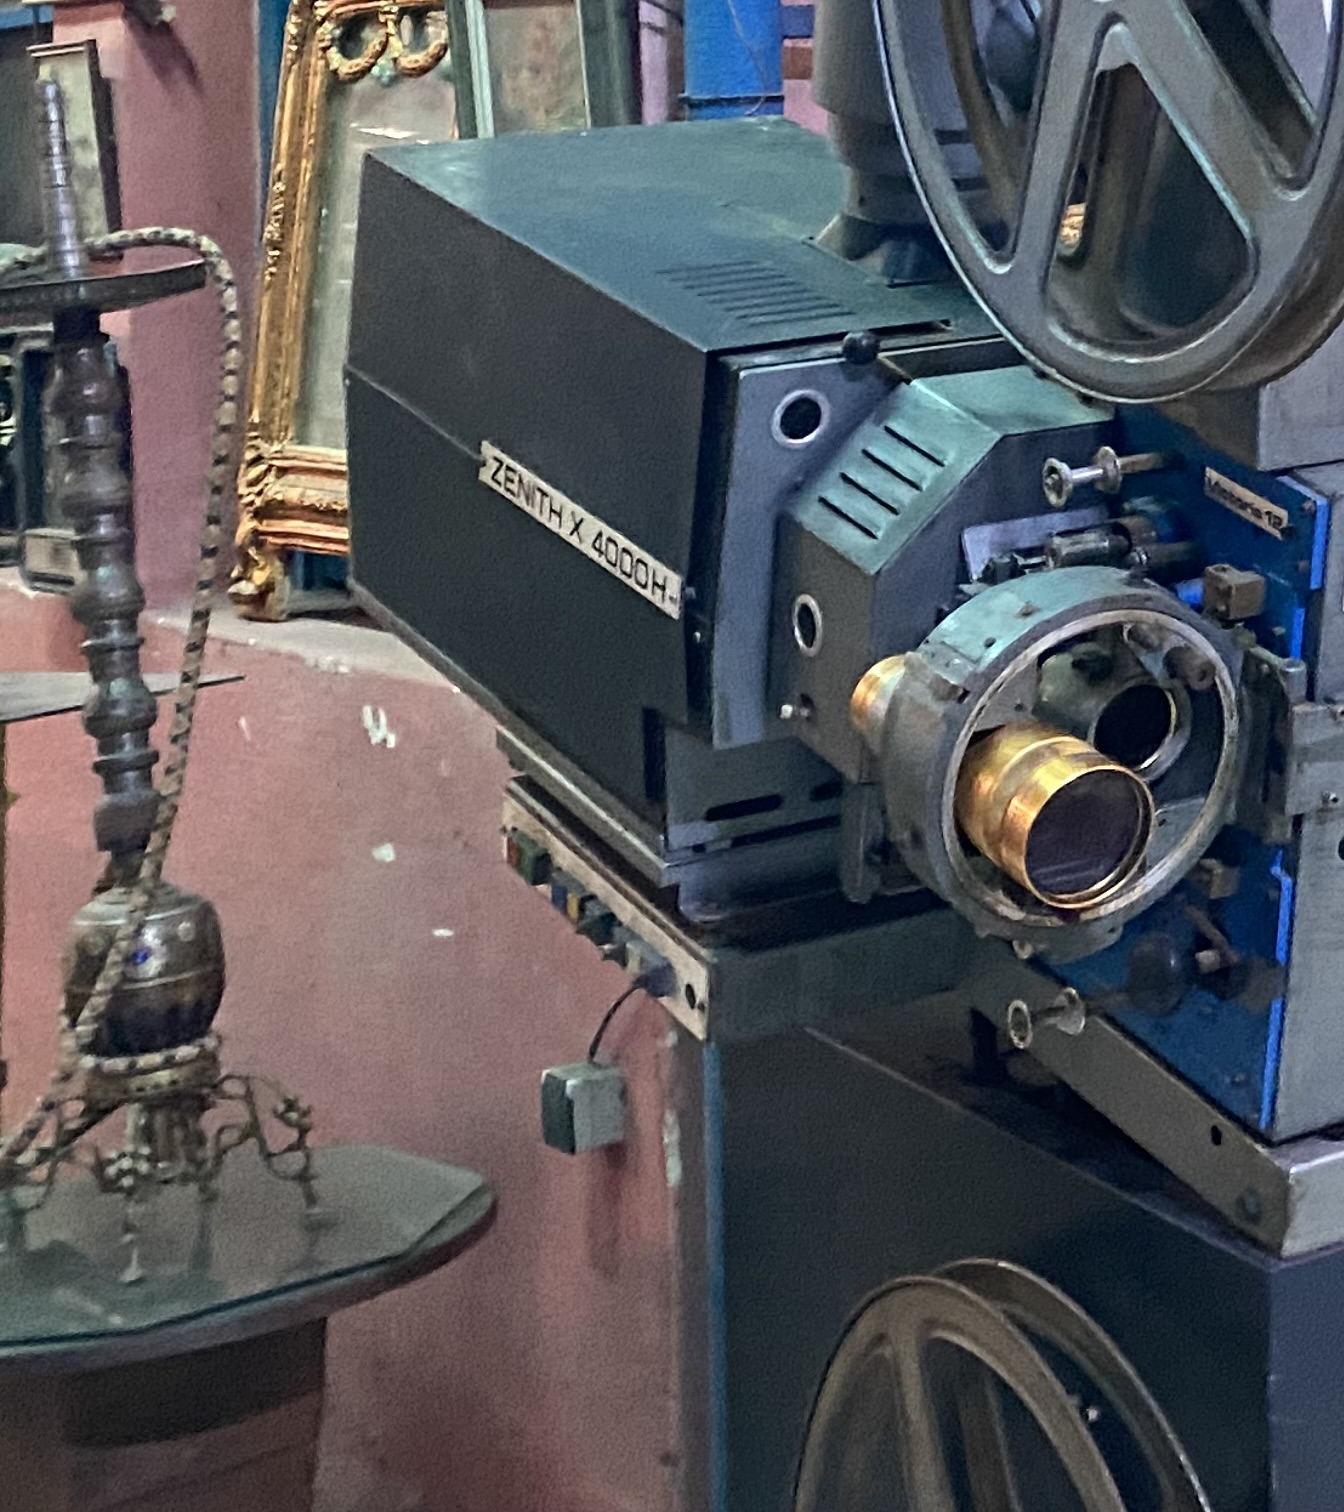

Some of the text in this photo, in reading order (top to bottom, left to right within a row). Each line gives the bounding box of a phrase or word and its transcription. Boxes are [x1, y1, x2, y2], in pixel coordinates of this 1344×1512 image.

[490, 456, 564, 529] ZENITH
[569, 510, 585, 544] X
[1264, 510, 1283, 530] 12
